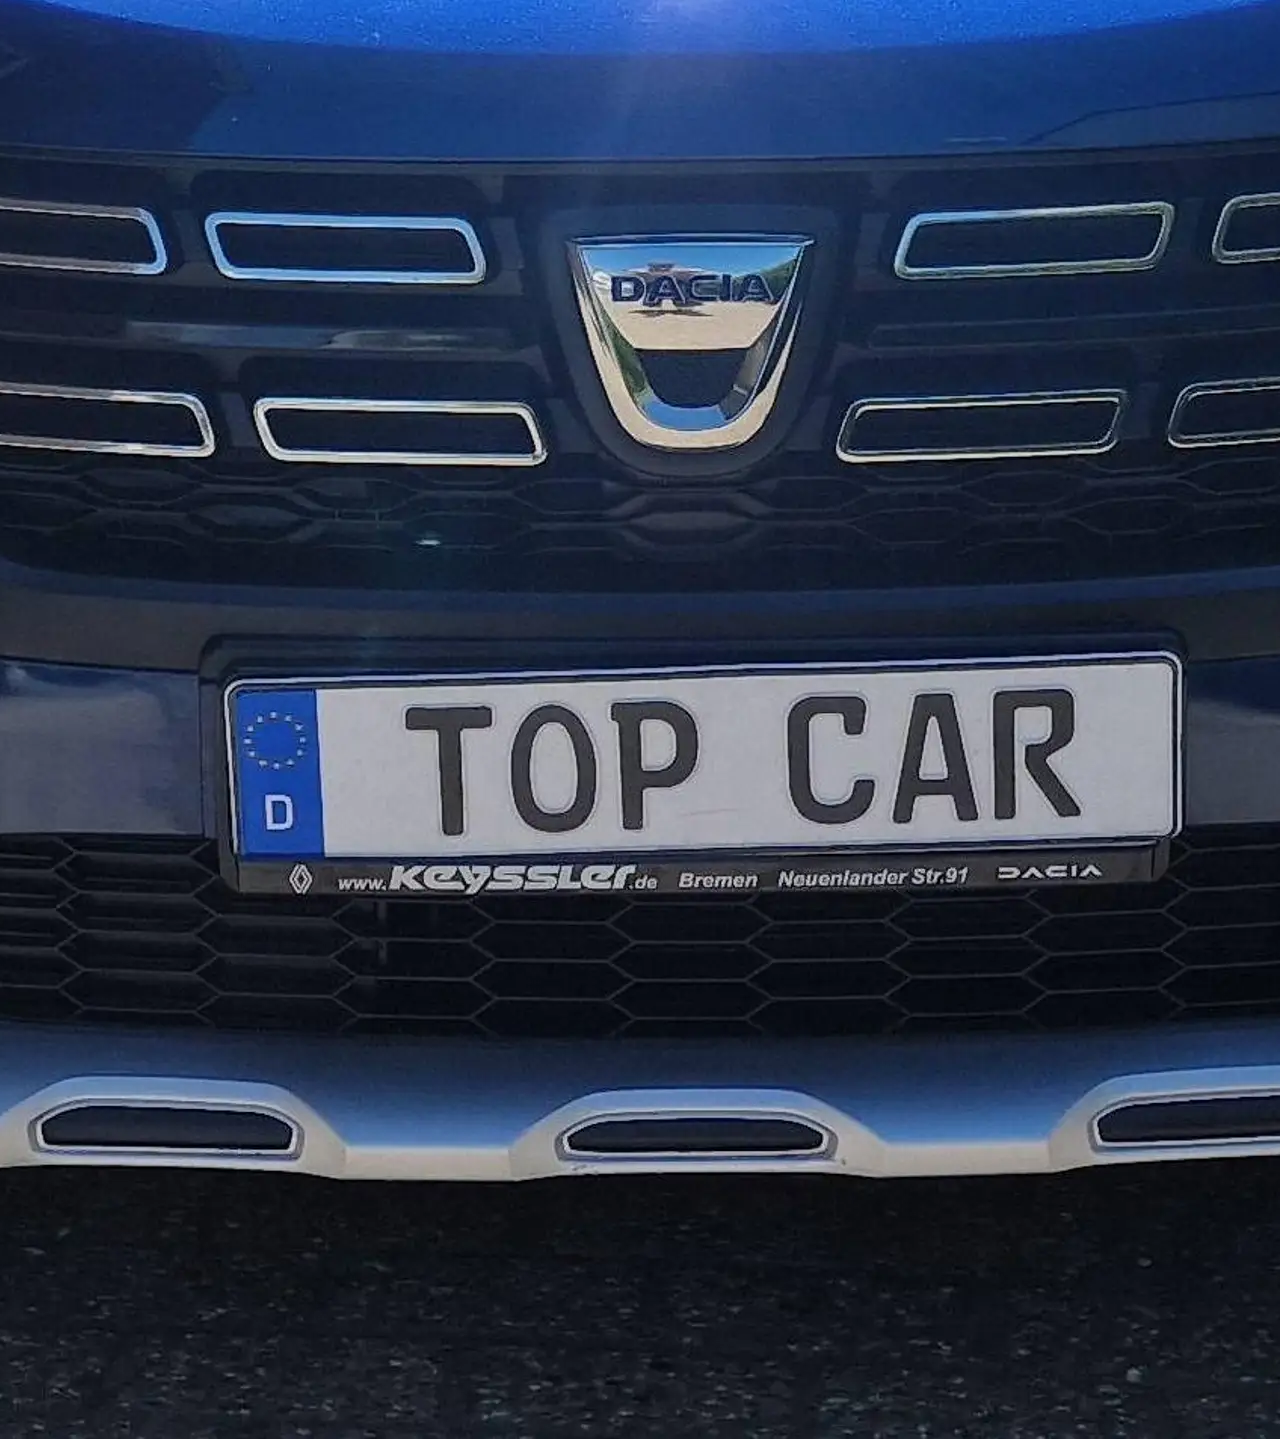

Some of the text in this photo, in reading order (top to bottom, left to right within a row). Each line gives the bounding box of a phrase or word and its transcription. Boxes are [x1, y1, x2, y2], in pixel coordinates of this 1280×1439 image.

[611, 274, 776, 304] DACIA
[405, 688, 1082, 836] TOP CAR
[264, 794, 294, 831] D
[678, 872, 758, 888] Bremen
[911, 866, 970, 885] Str.91
[997, 864, 1103, 879] DACIA
